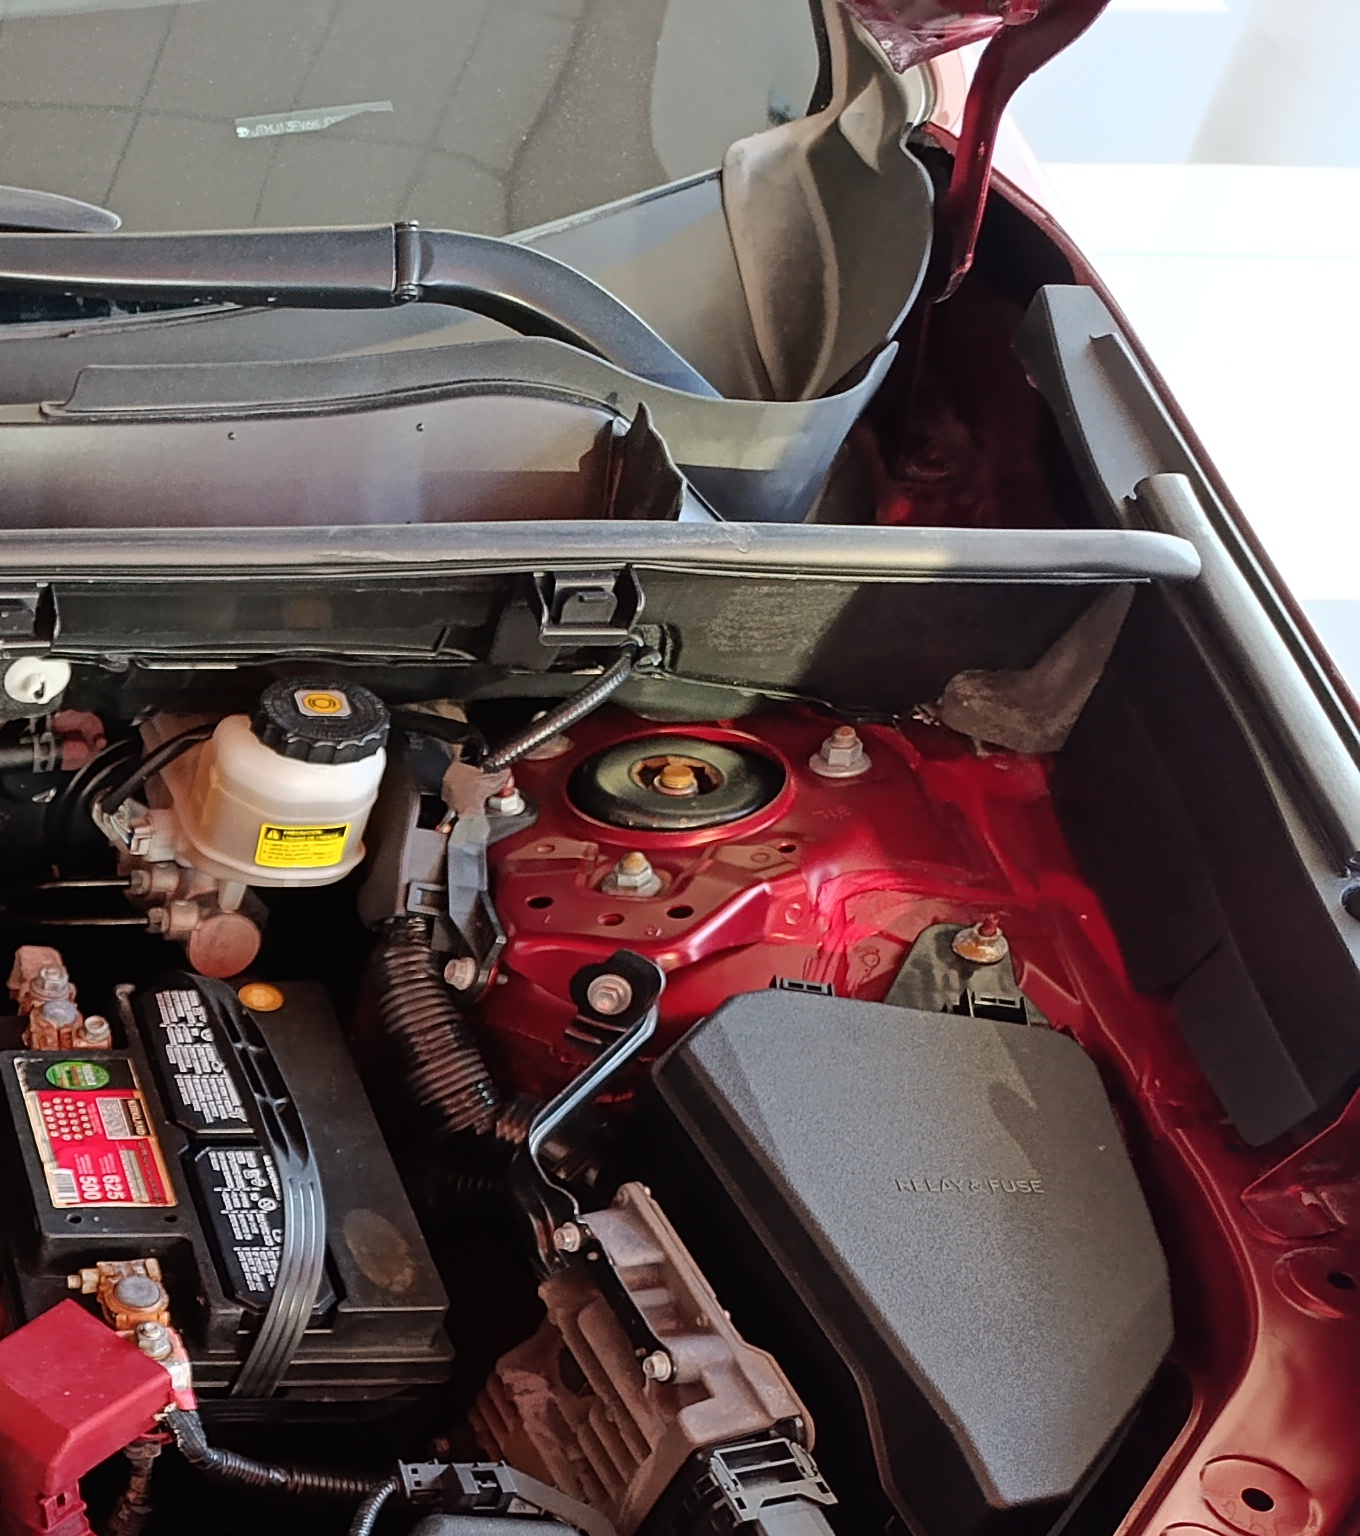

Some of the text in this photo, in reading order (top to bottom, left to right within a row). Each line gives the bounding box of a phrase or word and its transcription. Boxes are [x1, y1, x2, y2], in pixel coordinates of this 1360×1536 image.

[79, 1175, 103, 1201] 500
[102, 1174, 125, 1201] 625
[895, 1178, 1046, 1194] RELAY & FUSE
